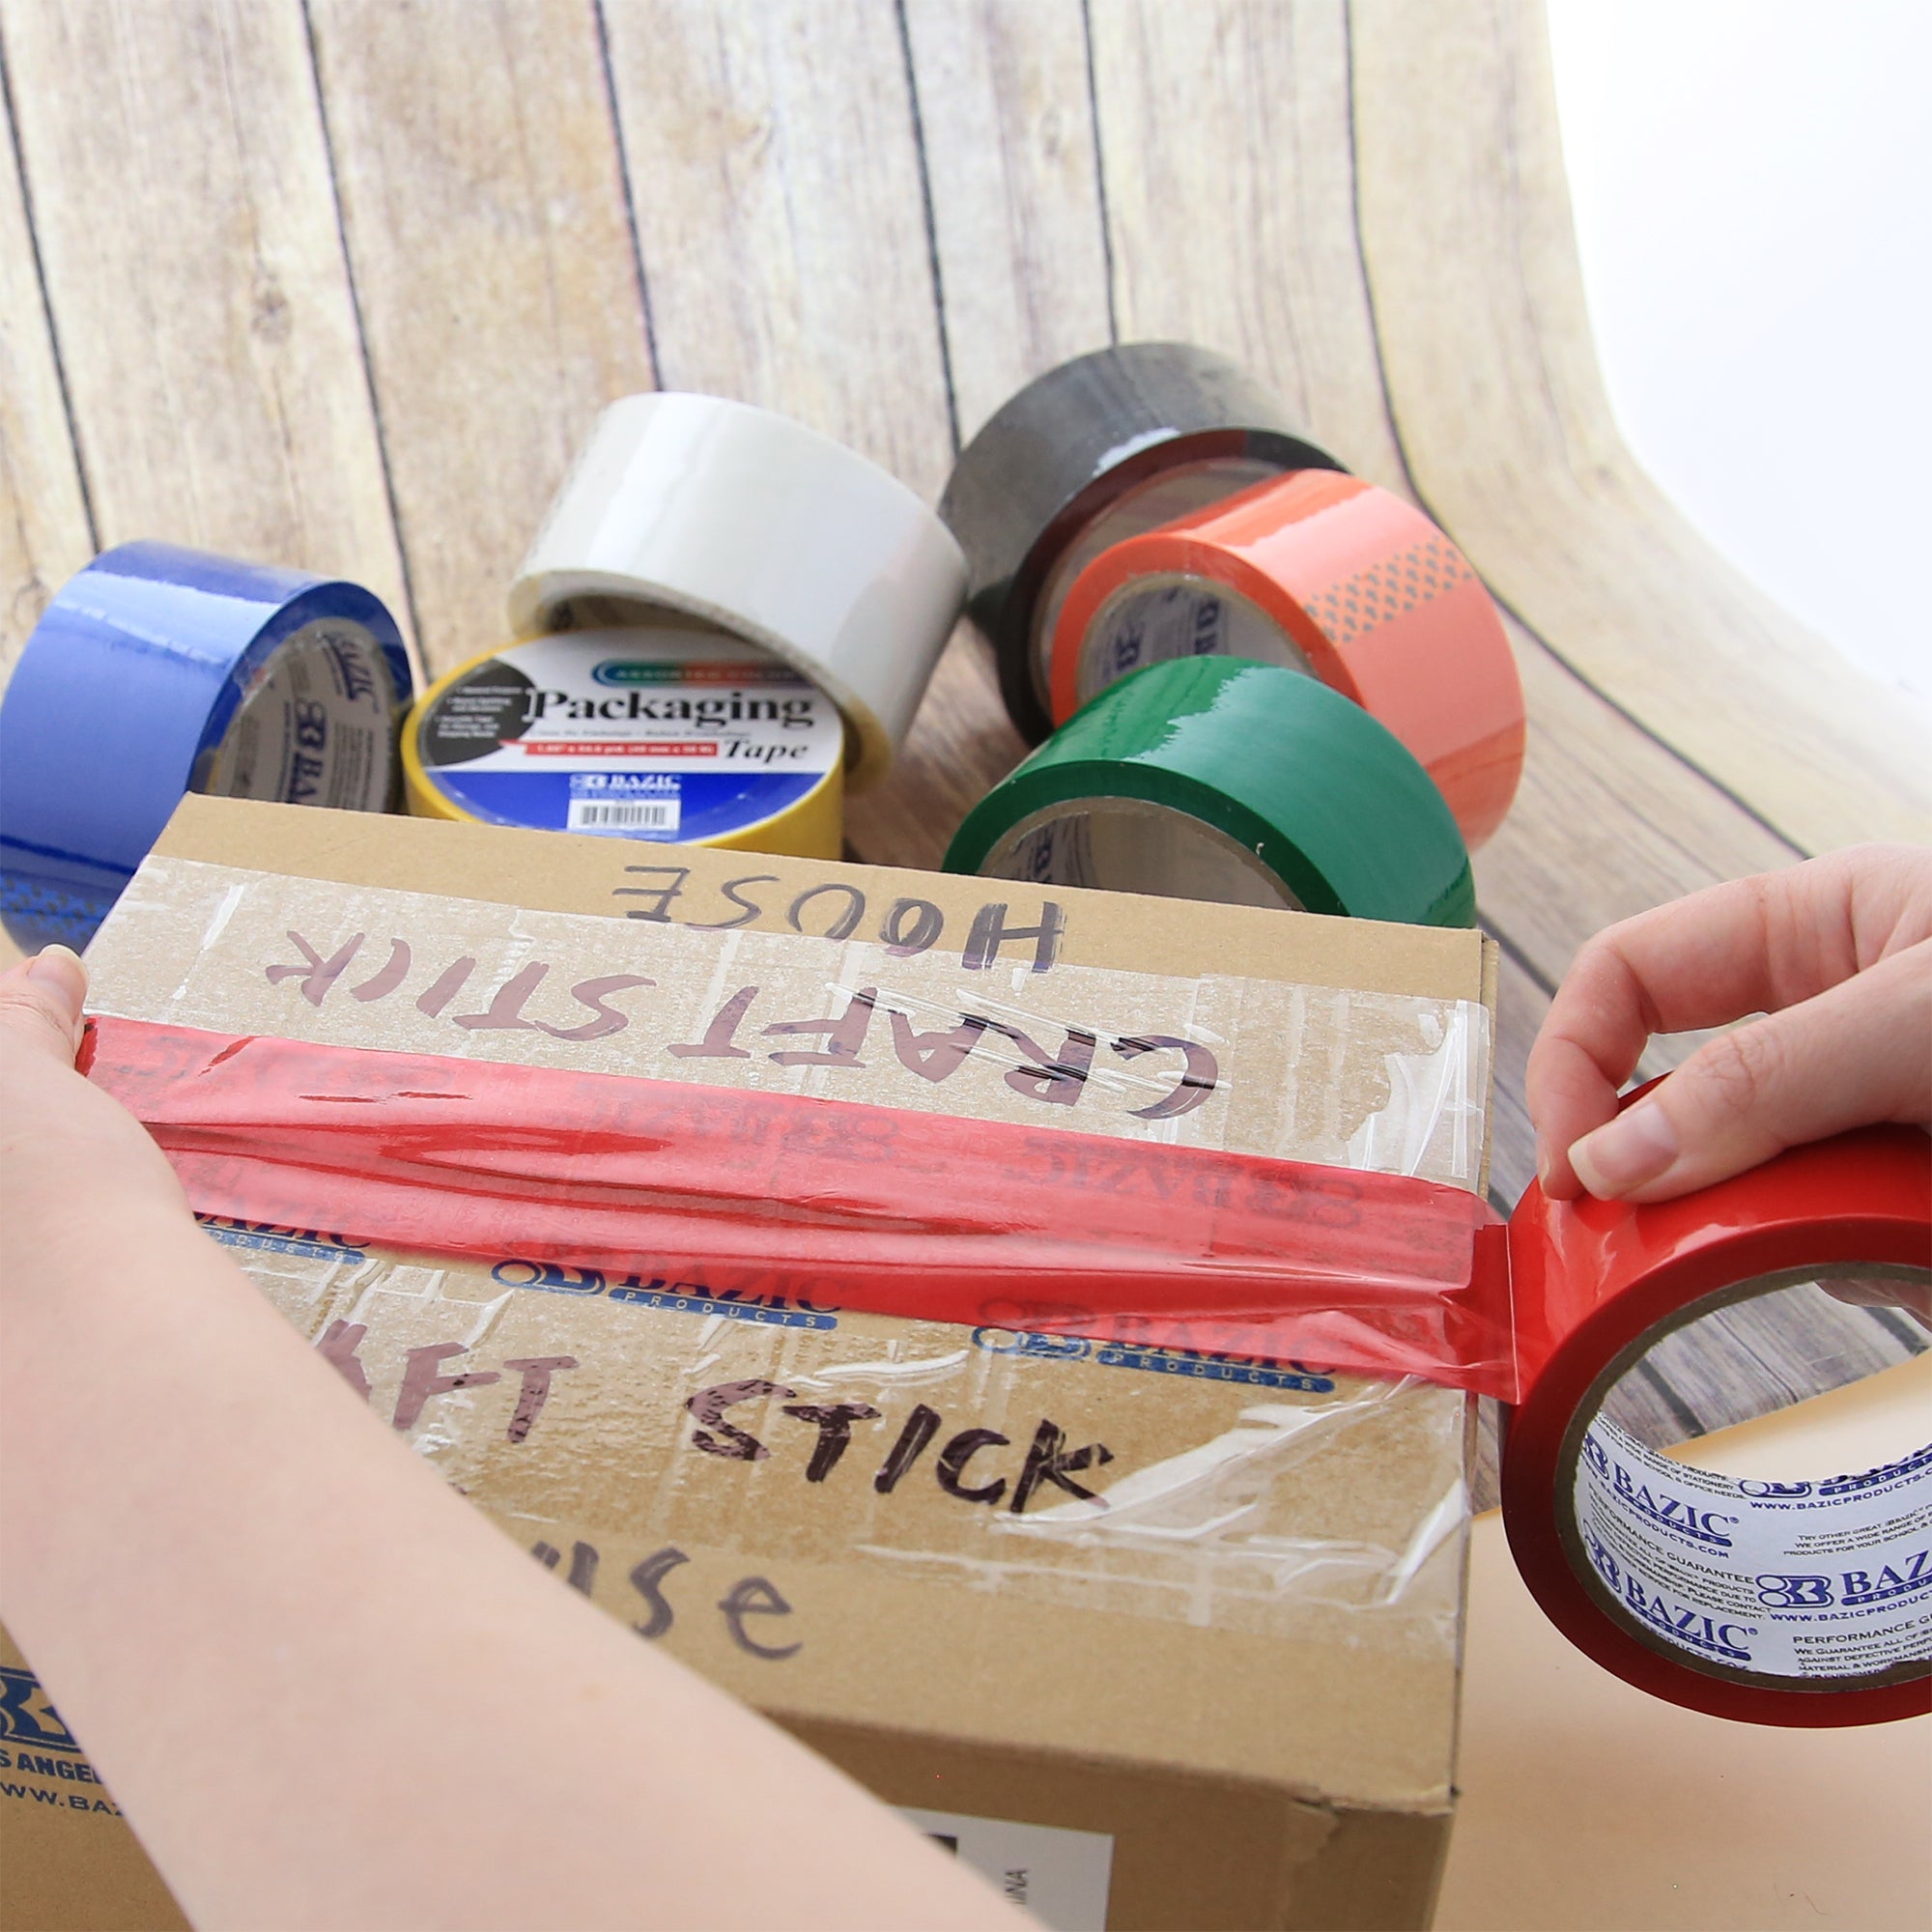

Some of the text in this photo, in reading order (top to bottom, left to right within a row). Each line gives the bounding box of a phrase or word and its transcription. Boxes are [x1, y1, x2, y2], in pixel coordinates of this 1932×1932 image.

[526, 690, 814, 730] Packaging
[725, 739, 810, 764] Tape
[612, 864, 1066, 974] HOUSE
[266, 929, 657, 1041] STICK
[666, 984, 1218, 1120] CRAFT
[621, 1291, 820, 1329] PRODUCTS
[1113, 1351, 1316, 1393] PRODUCTS
[684, 1378, 1115, 1514] STICK
[1783, 1548, 1834, 1556] PRODUCTS
[1835, 1544, 1856, 1552] FOR
[1813, 1537, 1846, 1548] OFFER
[1855, 1530, 1880, 1543] WIDE
[1818, 1530, 1851, 1540] OTHER
[1666, 1548, 1754, 1586] GUARANTEE
[1702, 1576, 1754, 1596] PRODUCTS
[1793, 1620, 1916, 1644] PERFORMANCE
[1815, 1642, 1882, 1656] GUARANTEE
[1883, 1638, 1904, 1648] ALL
[1843, 1646, 1901, 1662] DEFECTIVE
